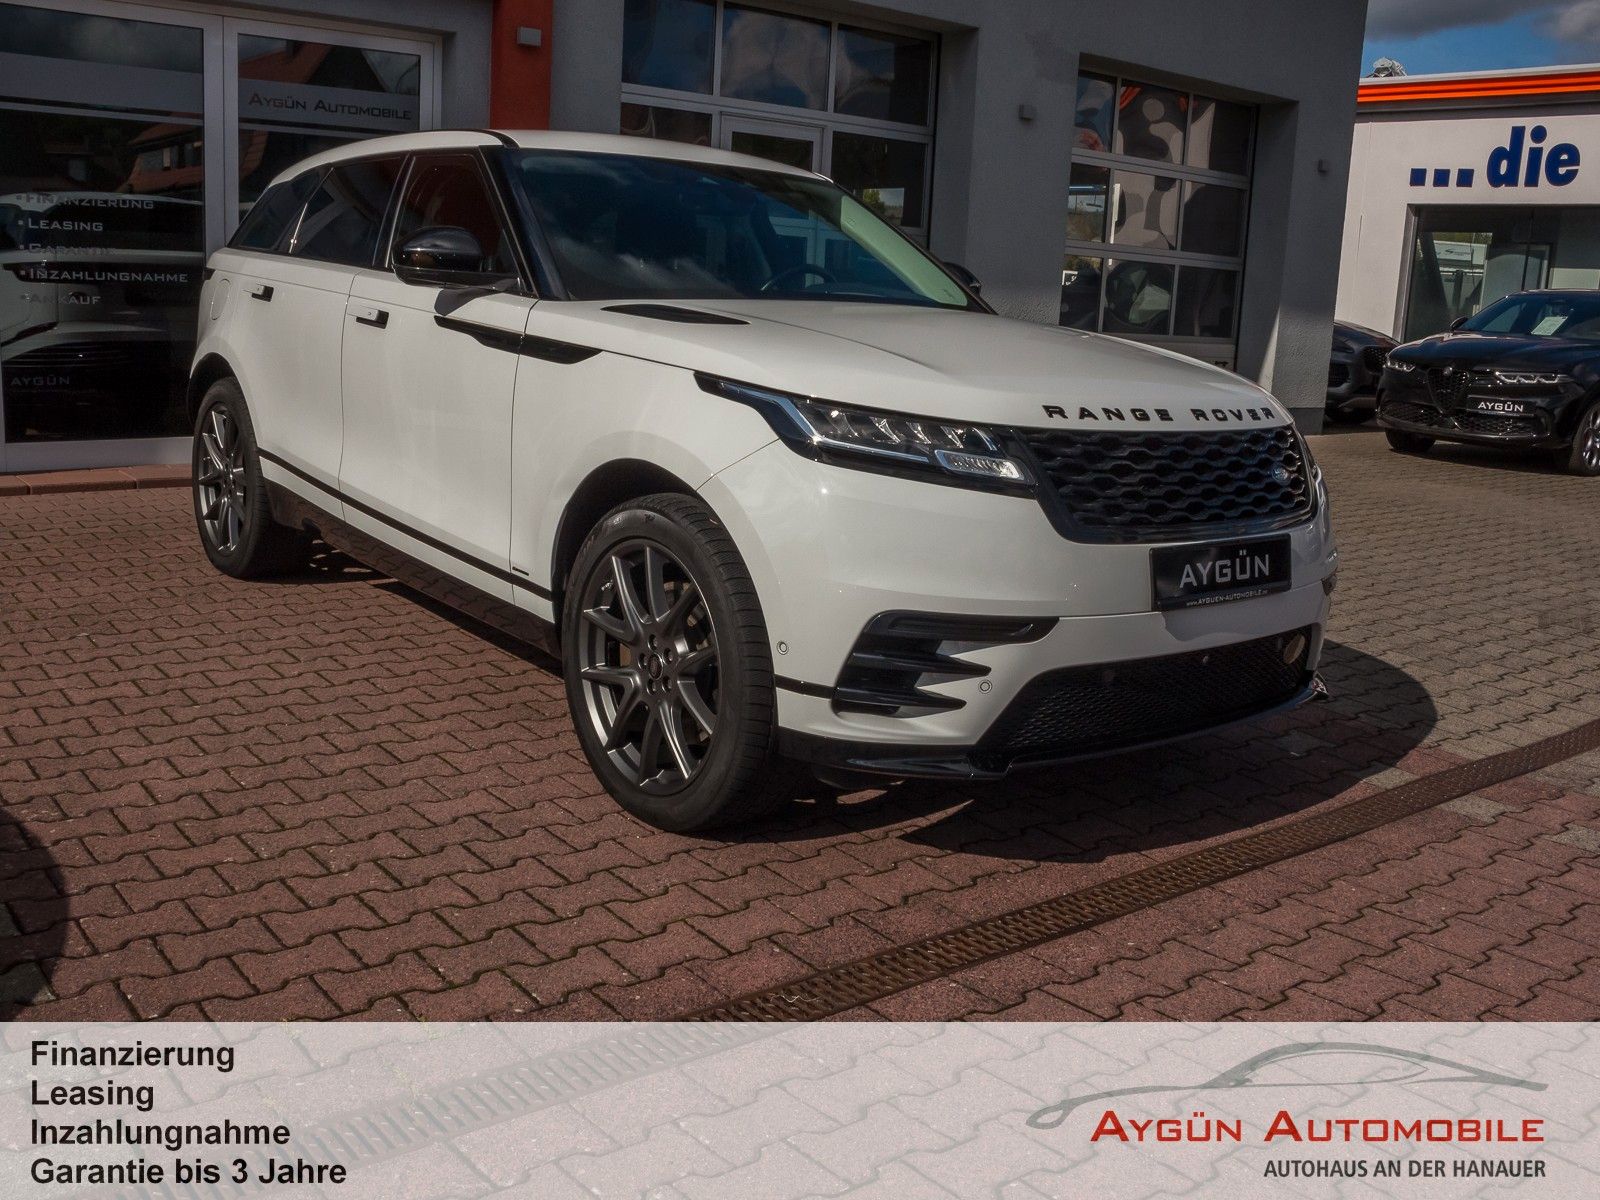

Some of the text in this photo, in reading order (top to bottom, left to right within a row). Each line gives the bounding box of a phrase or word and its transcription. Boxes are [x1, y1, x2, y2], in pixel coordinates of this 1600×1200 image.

[249, 93, 412, 121] AYGÜN AUTOMOBILE
[28, 217, 104, 232] LEASING
[29, 268, 188, 283] INZAHLUNGNAHME
[1041, 404, 1276, 422] RANGE ROVER
[1477, 401, 1524, 412] AYGÜN
[1179, 549, 1270, 589] AYGÜN
